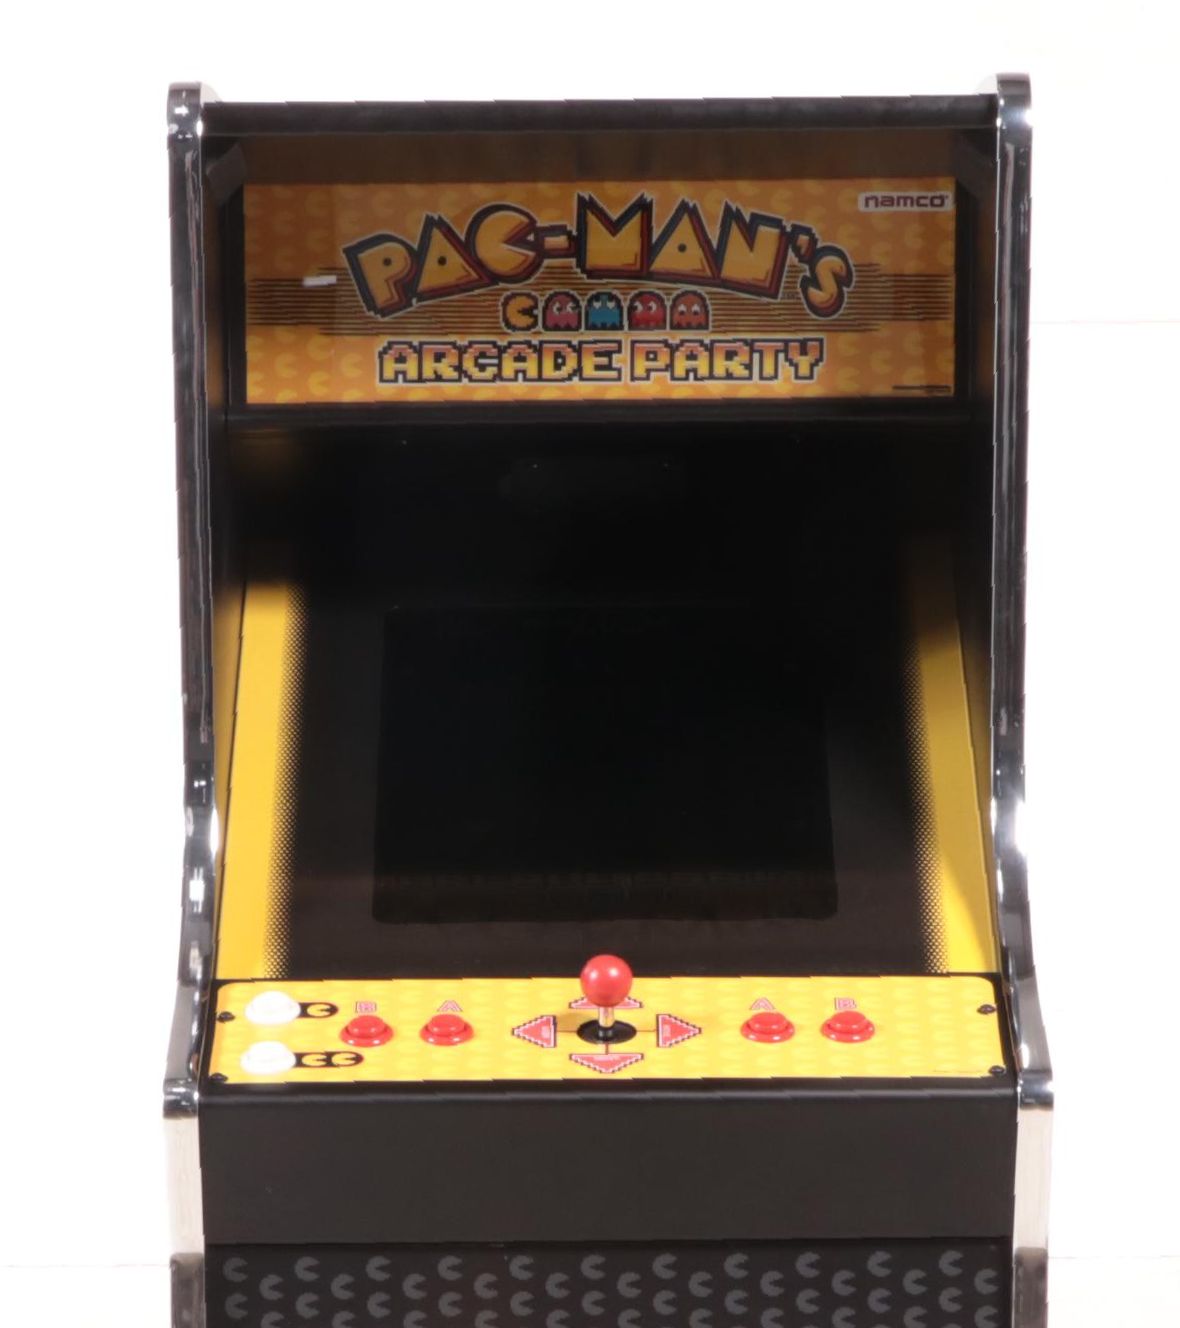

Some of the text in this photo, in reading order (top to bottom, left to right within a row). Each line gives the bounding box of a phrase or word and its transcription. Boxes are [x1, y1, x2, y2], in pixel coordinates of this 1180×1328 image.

[864, 195, 946, 208] namco
[376, 337, 825, 384] ARCADE PARTY
